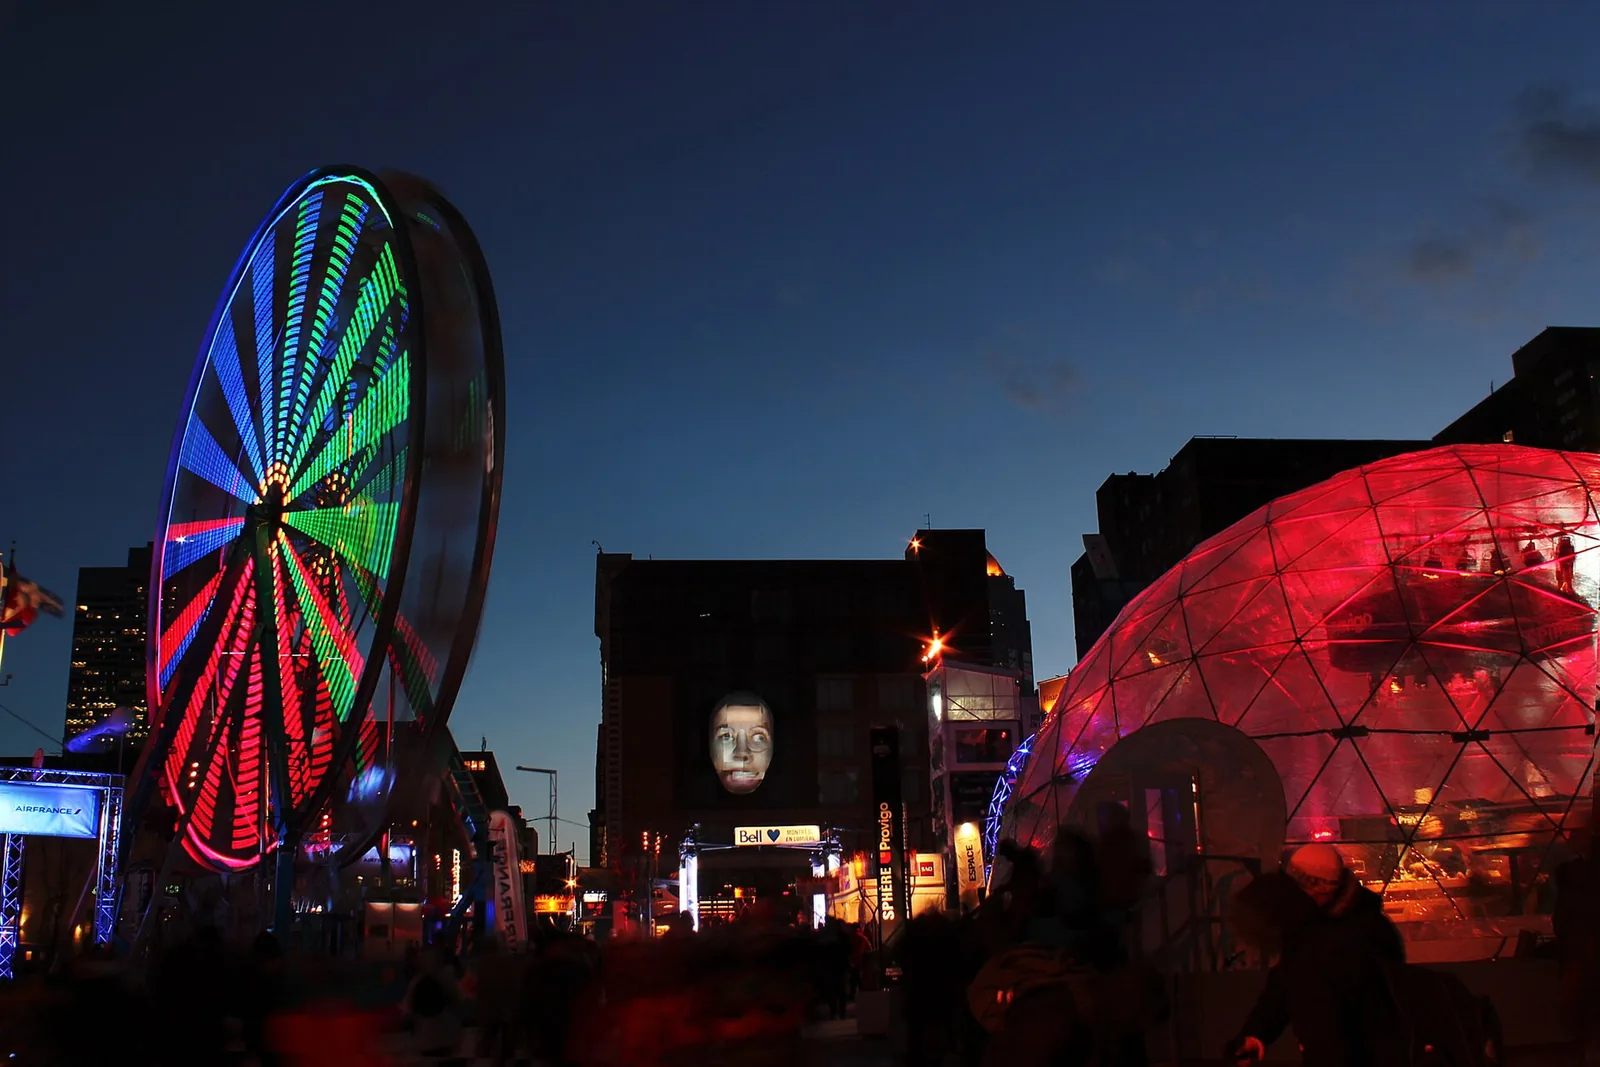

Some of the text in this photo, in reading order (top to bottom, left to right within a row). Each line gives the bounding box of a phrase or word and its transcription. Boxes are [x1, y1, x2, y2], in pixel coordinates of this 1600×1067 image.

[15, 805, 72, 815] AIRFRANCE
[739, 829, 763, 843] Bell
[877, 801, 895, 920] SPHÈRE Provigo
[965, 844, 977, 882] ESPACE
